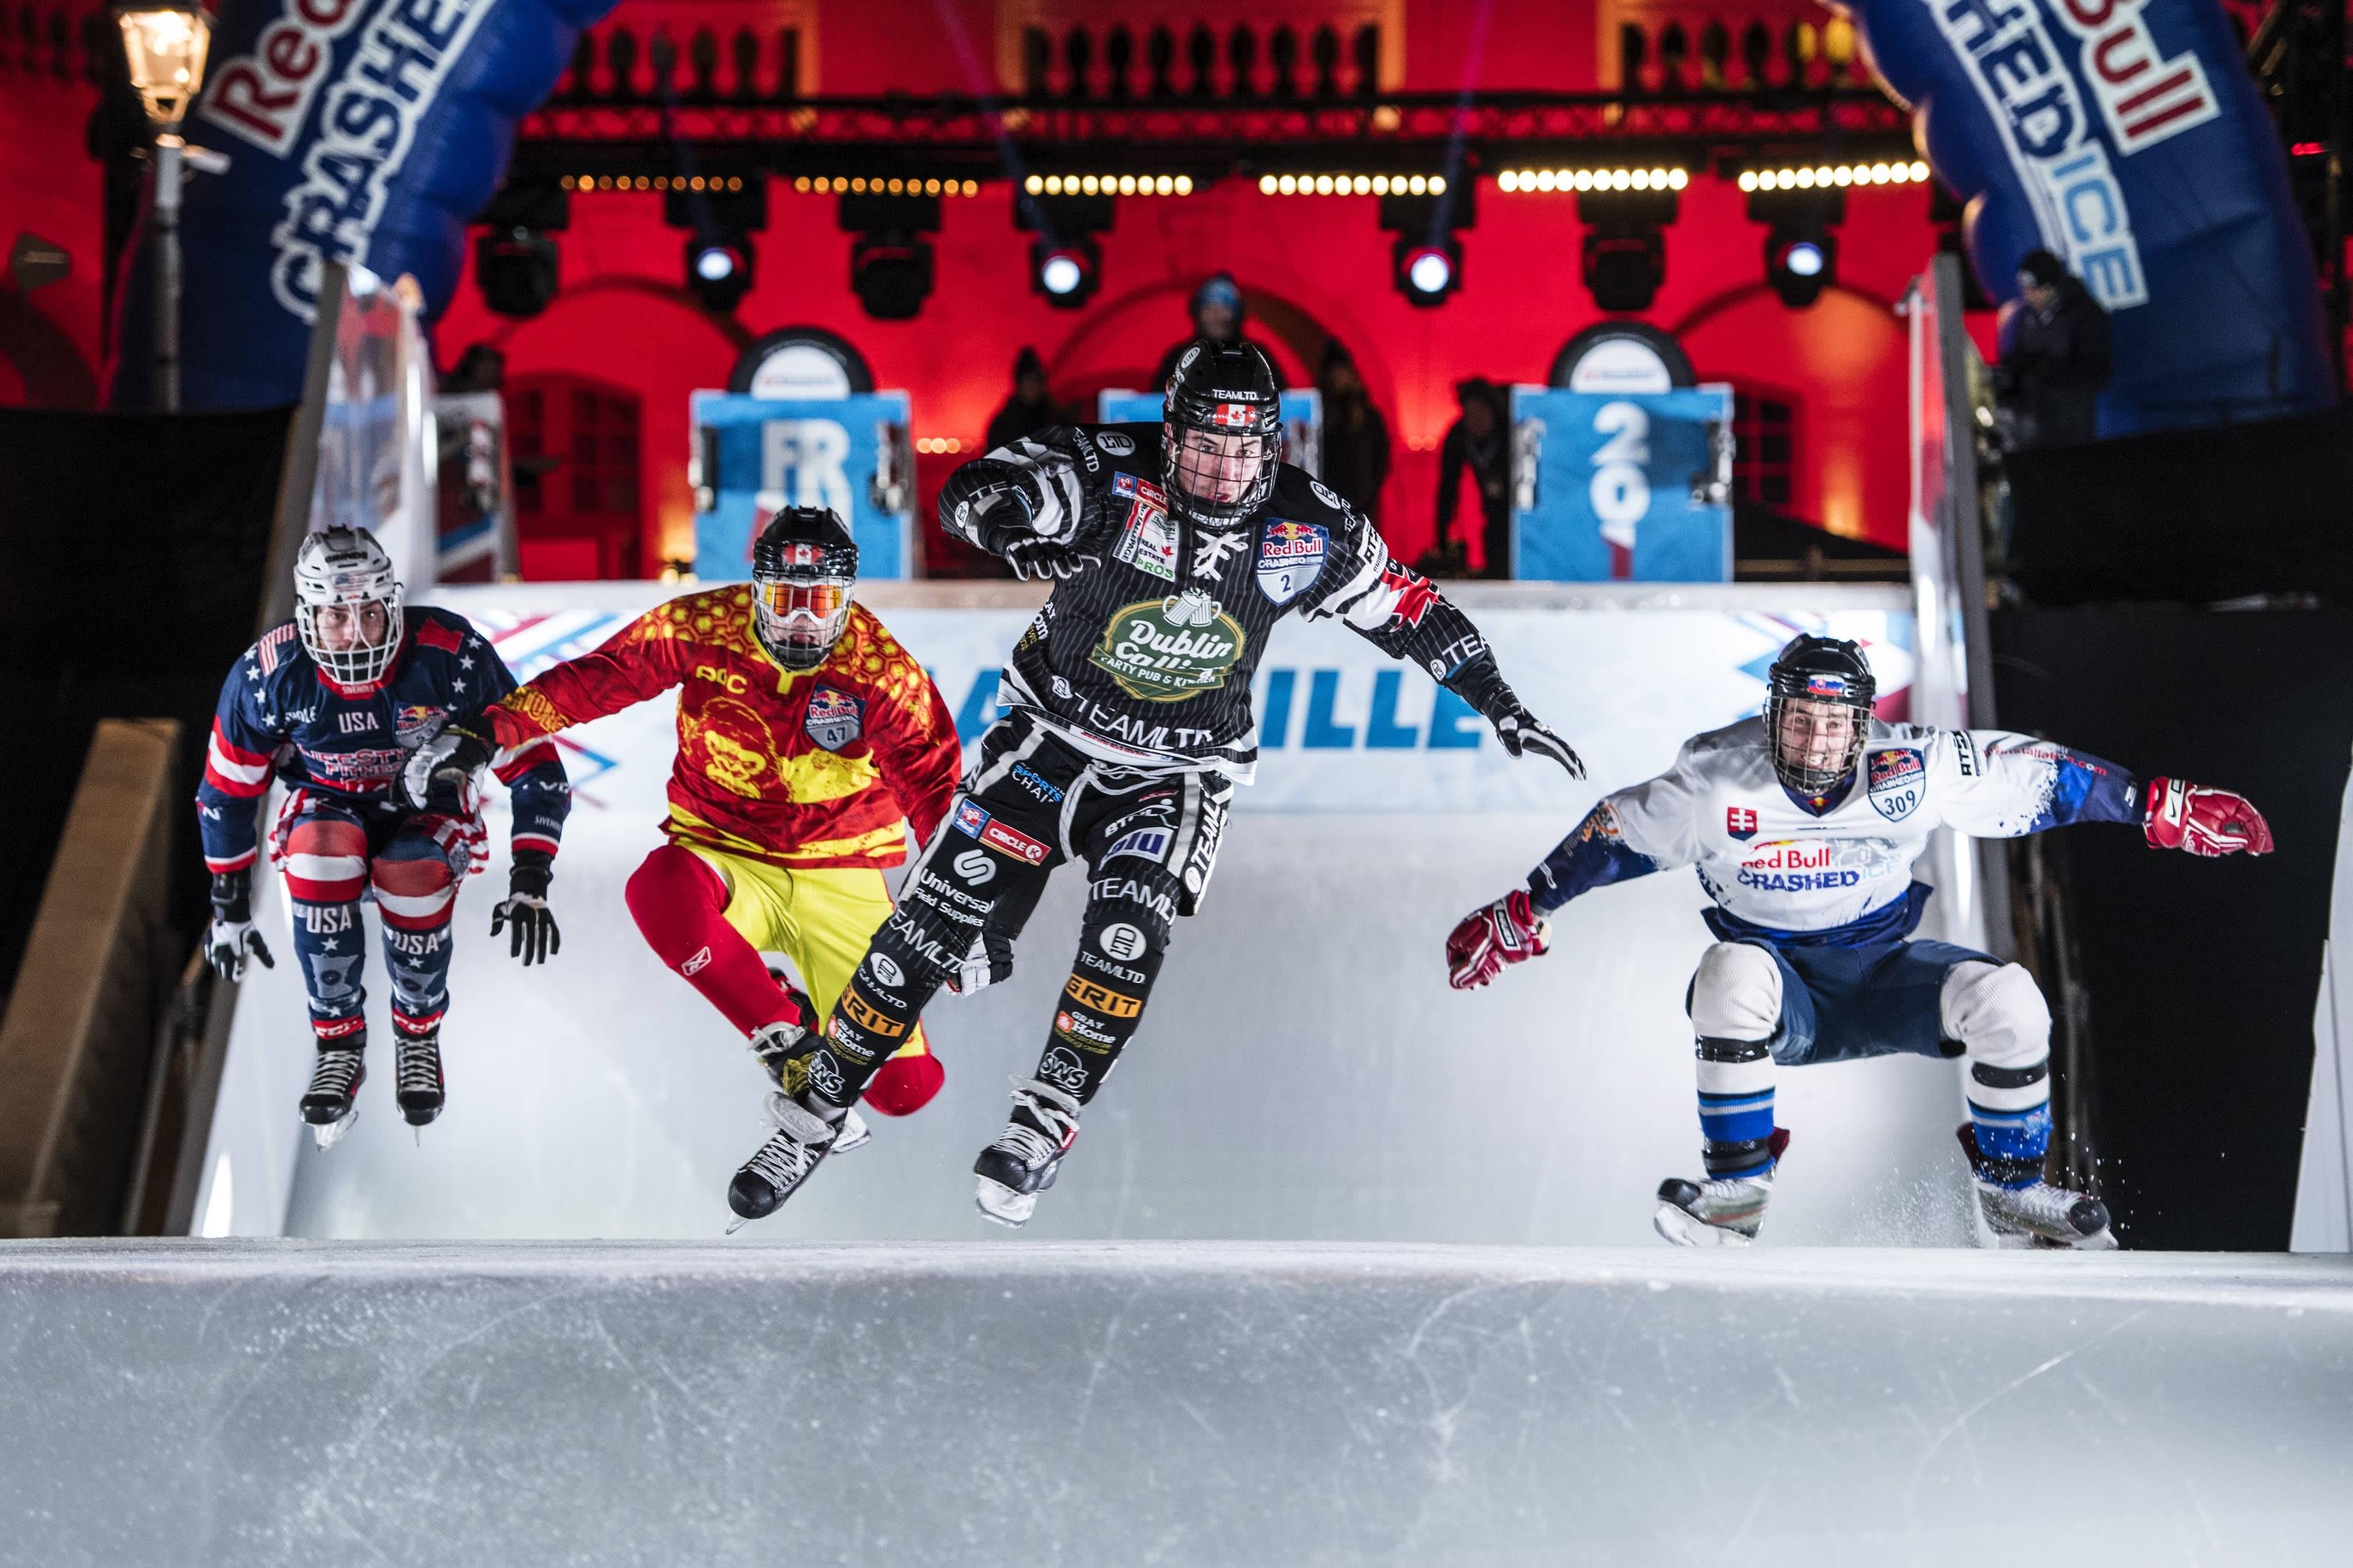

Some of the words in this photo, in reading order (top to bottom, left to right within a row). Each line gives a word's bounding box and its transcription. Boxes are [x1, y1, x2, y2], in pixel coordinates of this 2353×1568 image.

[2049, 147, 2140, 303] ICE
[1263, 540, 1293, 556] Red
[1294, 538, 1323, 555] Bull
[1136, 557, 1174, 579] PROS
[1280, 574, 1291, 593] 2
[1129, 619, 1234, 659] Dublin
[1137, 668, 1162, 682] PUB
[1162, 675, 1173, 684] &
[338, 711, 380, 734] USA
[809, 705, 835, 718] Red
[826, 726, 846, 743] 47
[1871, 765, 1896, 784] Red
[1896, 757, 1921, 773] Bull
[1884, 790, 1916, 815] 309
[989, 827, 1028, 851] CIRCLE
[1787, 847, 1830, 869] Bull
[919, 867, 995, 914] Universal
[1737, 870, 1860, 892] CRASHED
[306, 904, 353, 934] USA
[938, 901, 985, 927] Supplies
[393, 931, 440, 956] USA
[835, 1027, 876, 1057] Home
[1071, 1020, 1117, 1044] Home
